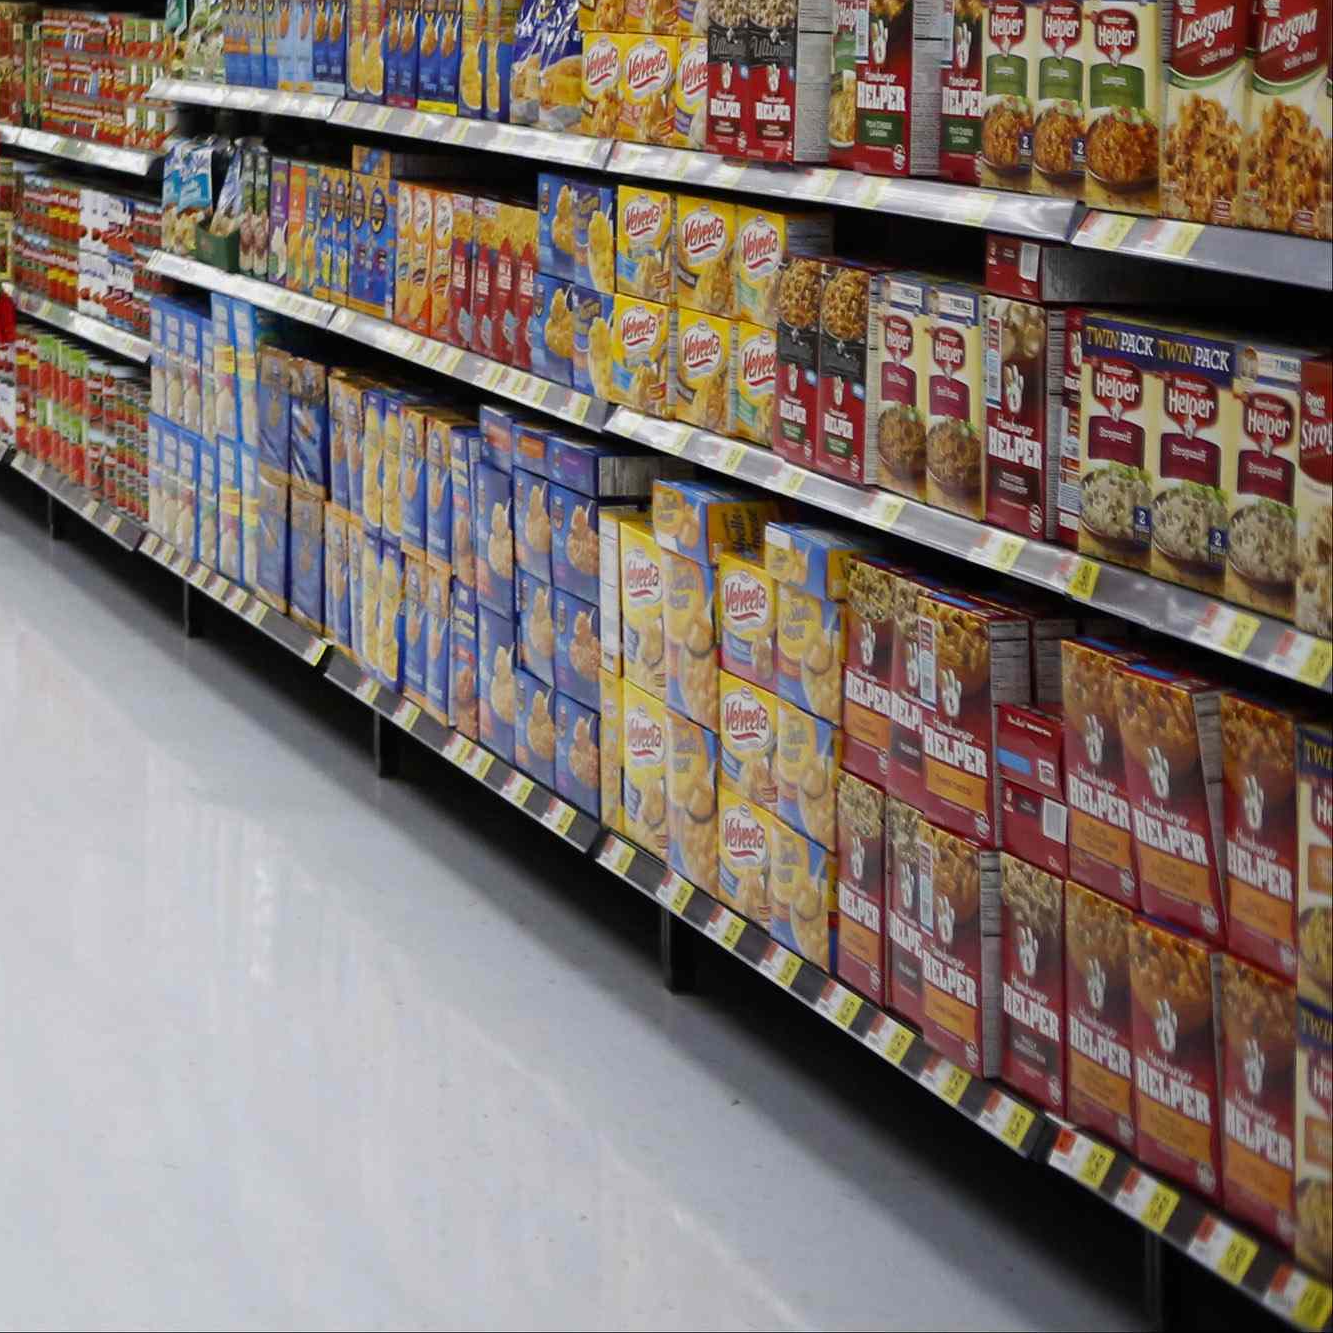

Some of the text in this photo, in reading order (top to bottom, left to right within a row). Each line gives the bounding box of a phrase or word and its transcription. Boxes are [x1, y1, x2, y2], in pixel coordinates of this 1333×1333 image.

[991, 14, 1024, 38] Helper
[1044, 13, 1080, 38] Helper
[1098, 23, 1135, 49] Helper
[1176, 5, 1235, 49] Lasagna
[1260, 8, 1318, 53] Lasagna
[586, 47, 618, 80] Velveeta
[628, 50, 668, 83] Velveeta
[710, 98, 741, 118] HELPER
[755, 101, 792, 122] HELPER
[856, 81, 906, 110] HELPER
[624, 198, 662, 229] Velveeta
[682, 216, 725, 249] Velveeta
[740, 230, 780, 261] Velveeta
[621, 309, 659, 340] Velveeta
[680, 334, 721, 363] Velveeta
[935, 343, 965, 365] Helper
[1086, 325, 1231, 372] TWIN PACK TWIN PACK
[1095, 374, 1140, 402] Helper
[1167, 388, 1215, 418] Helper
[1246, 408, 1291, 437] Helper
[988, 425, 1042, 470] HELPER
[1139, 510, 1146, 524] 2
[1214, 531, 1222, 547] 2
[724, 581, 766, 613] Velveeta
[845, 668, 891, 716] HELPER
[724, 705, 768, 734] Velveeta
[924, 722, 987, 778] HELPER
[1068, 774, 1131, 831] HELPER
[724, 815, 766, 854] Velveeta
[1134, 809, 1209, 866] HELPER
[1226, 840, 1293, 902] HELPER
[838, 890, 879, 934] HELPER
[923, 954, 977, 1008] HELPER
[1002, 980, 1060, 1043] HELPER
[1069, 1013, 1131, 1075] HELPER
[1135, 1059, 1211, 1125] HELPER
[1225, 1098, 1293, 1170] HELPER
